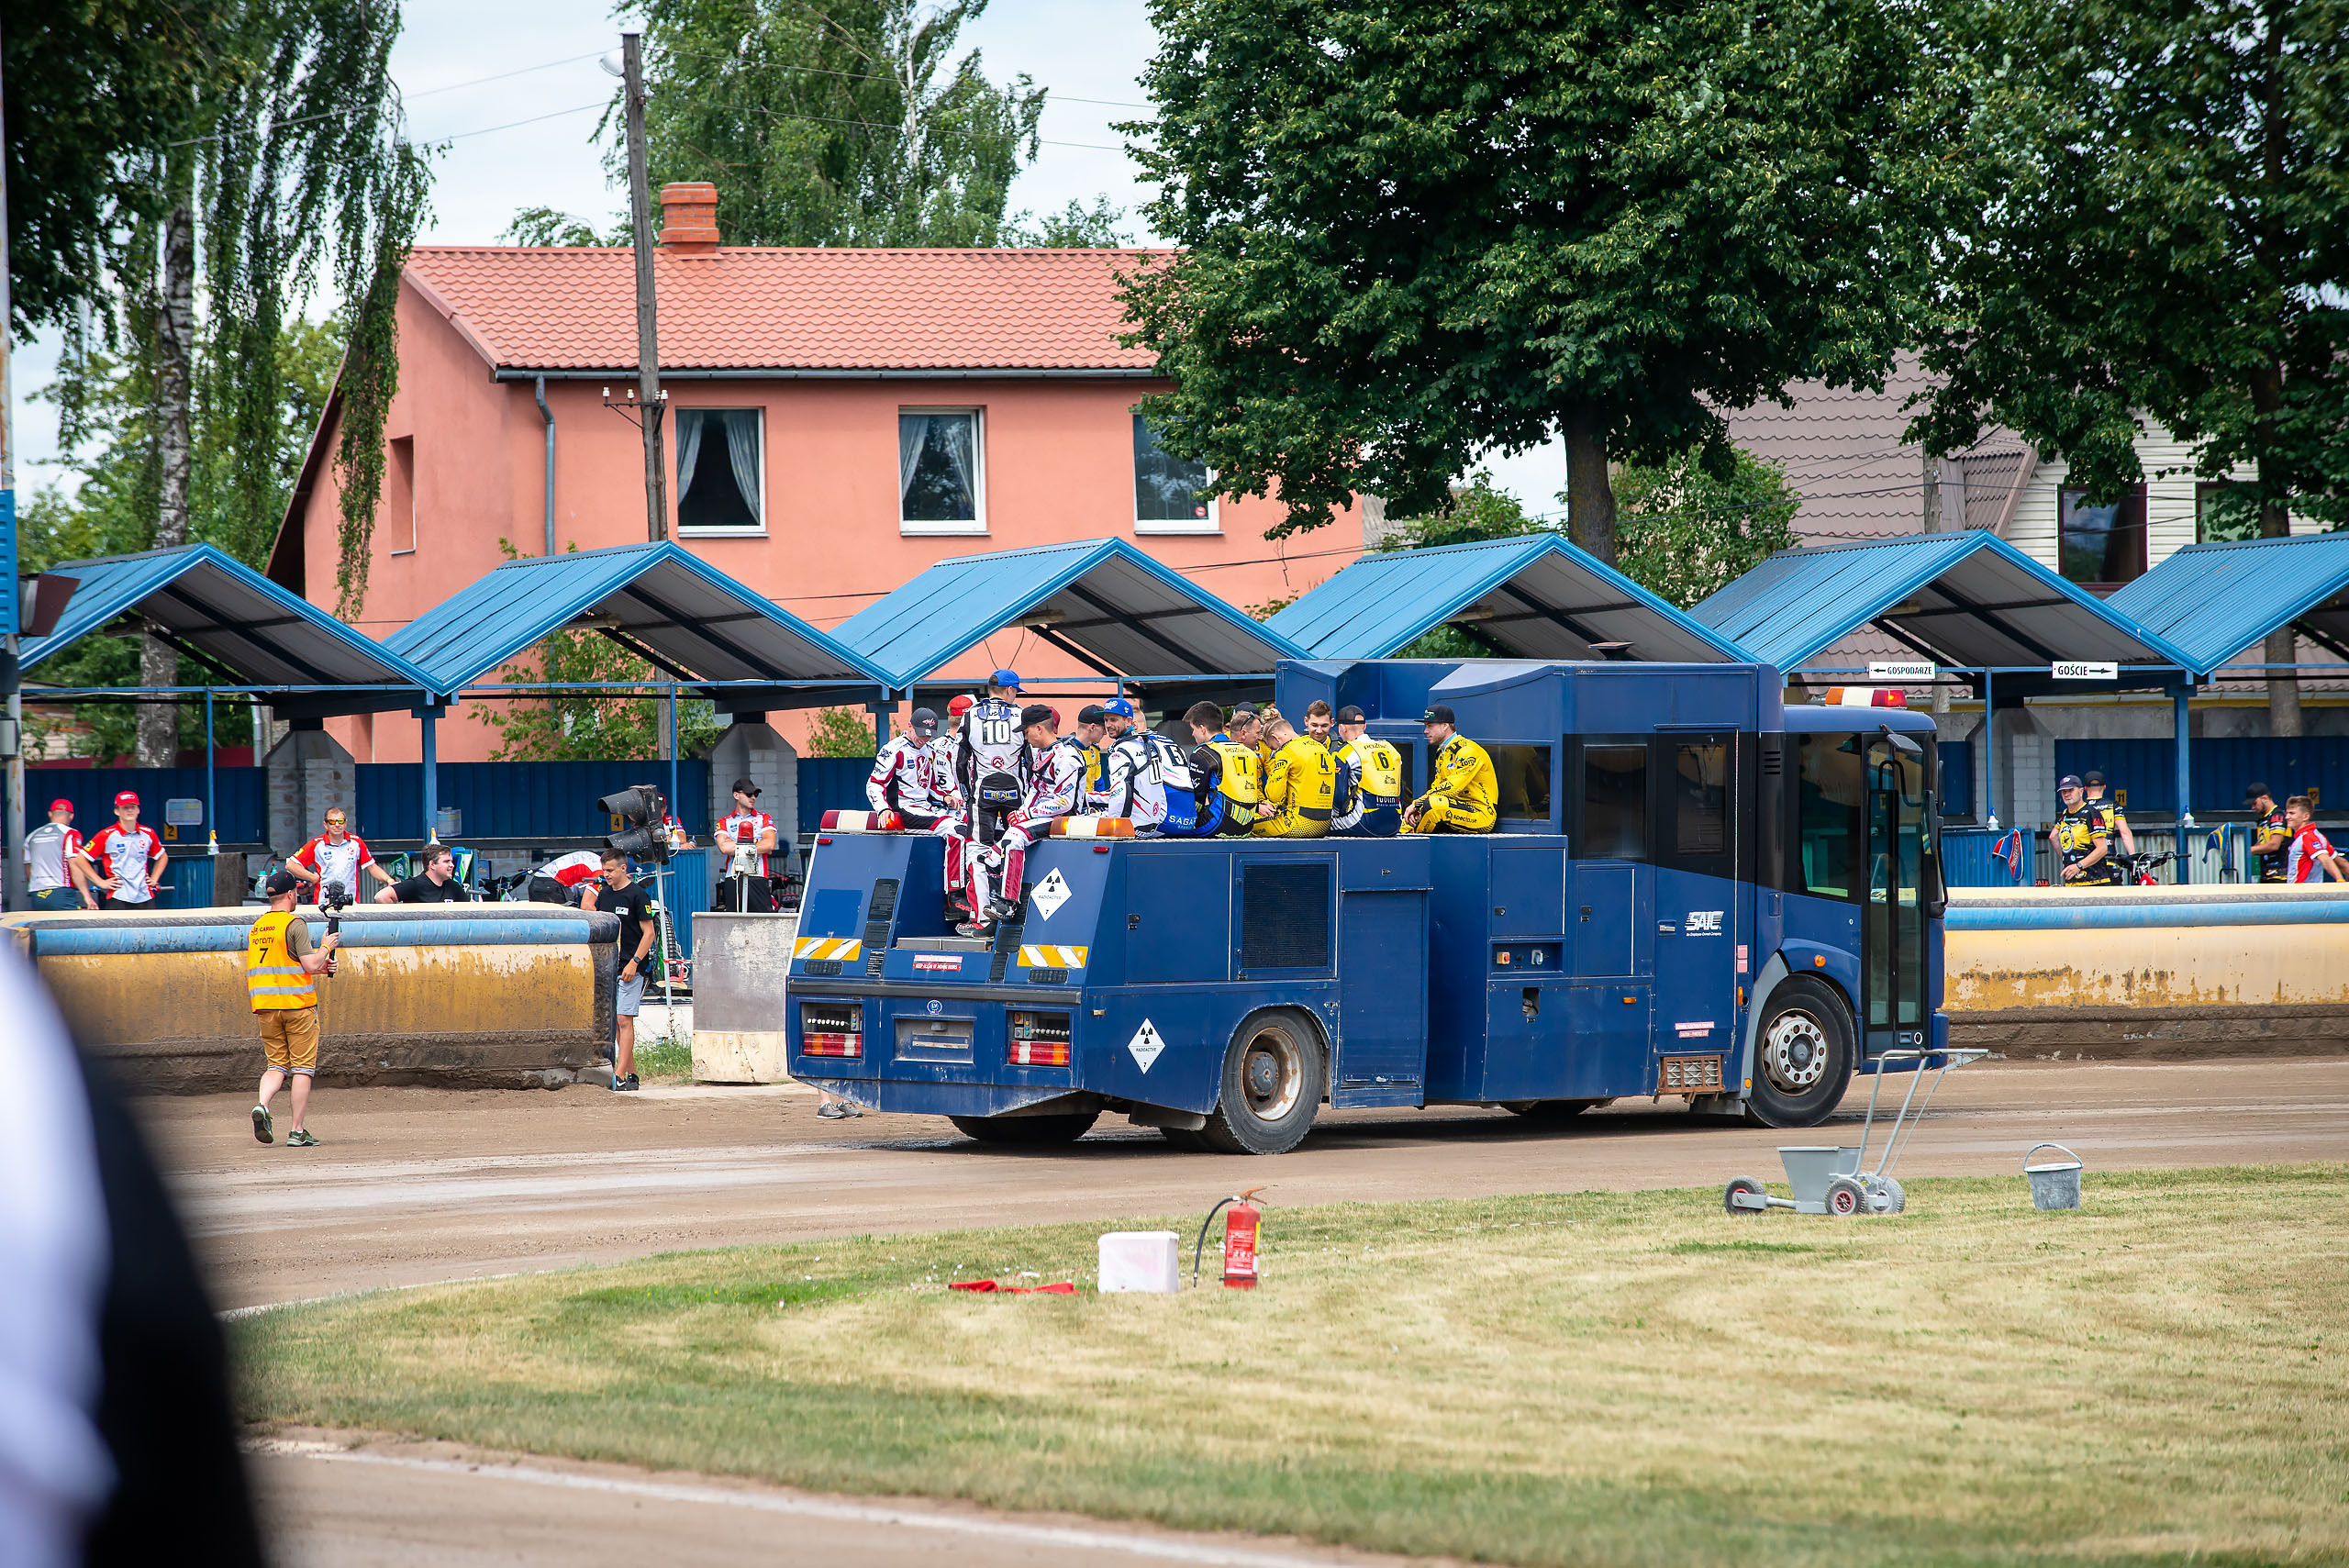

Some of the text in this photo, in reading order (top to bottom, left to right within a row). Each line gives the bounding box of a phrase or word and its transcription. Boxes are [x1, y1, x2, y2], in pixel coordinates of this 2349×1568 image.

[1887, 666, 1932, 675] GOSPODARZE
[2057, 663, 2087, 676] GOŚCIE
[983, 719, 1010, 744] 10
[1171, 745, 1185, 765] 5
[1319, 753, 1330, 773] 4
[1377, 751, 1390, 769] 6
[1237, 756, 1248, 774] 7
[2116, 792, 2126, 805] 11
[613, 816, 621, 828] 4
[166, 827, 175, 838] 2
[1685, 911, 1724, 930] SAIC
[259, 947, 269, 964] 7
